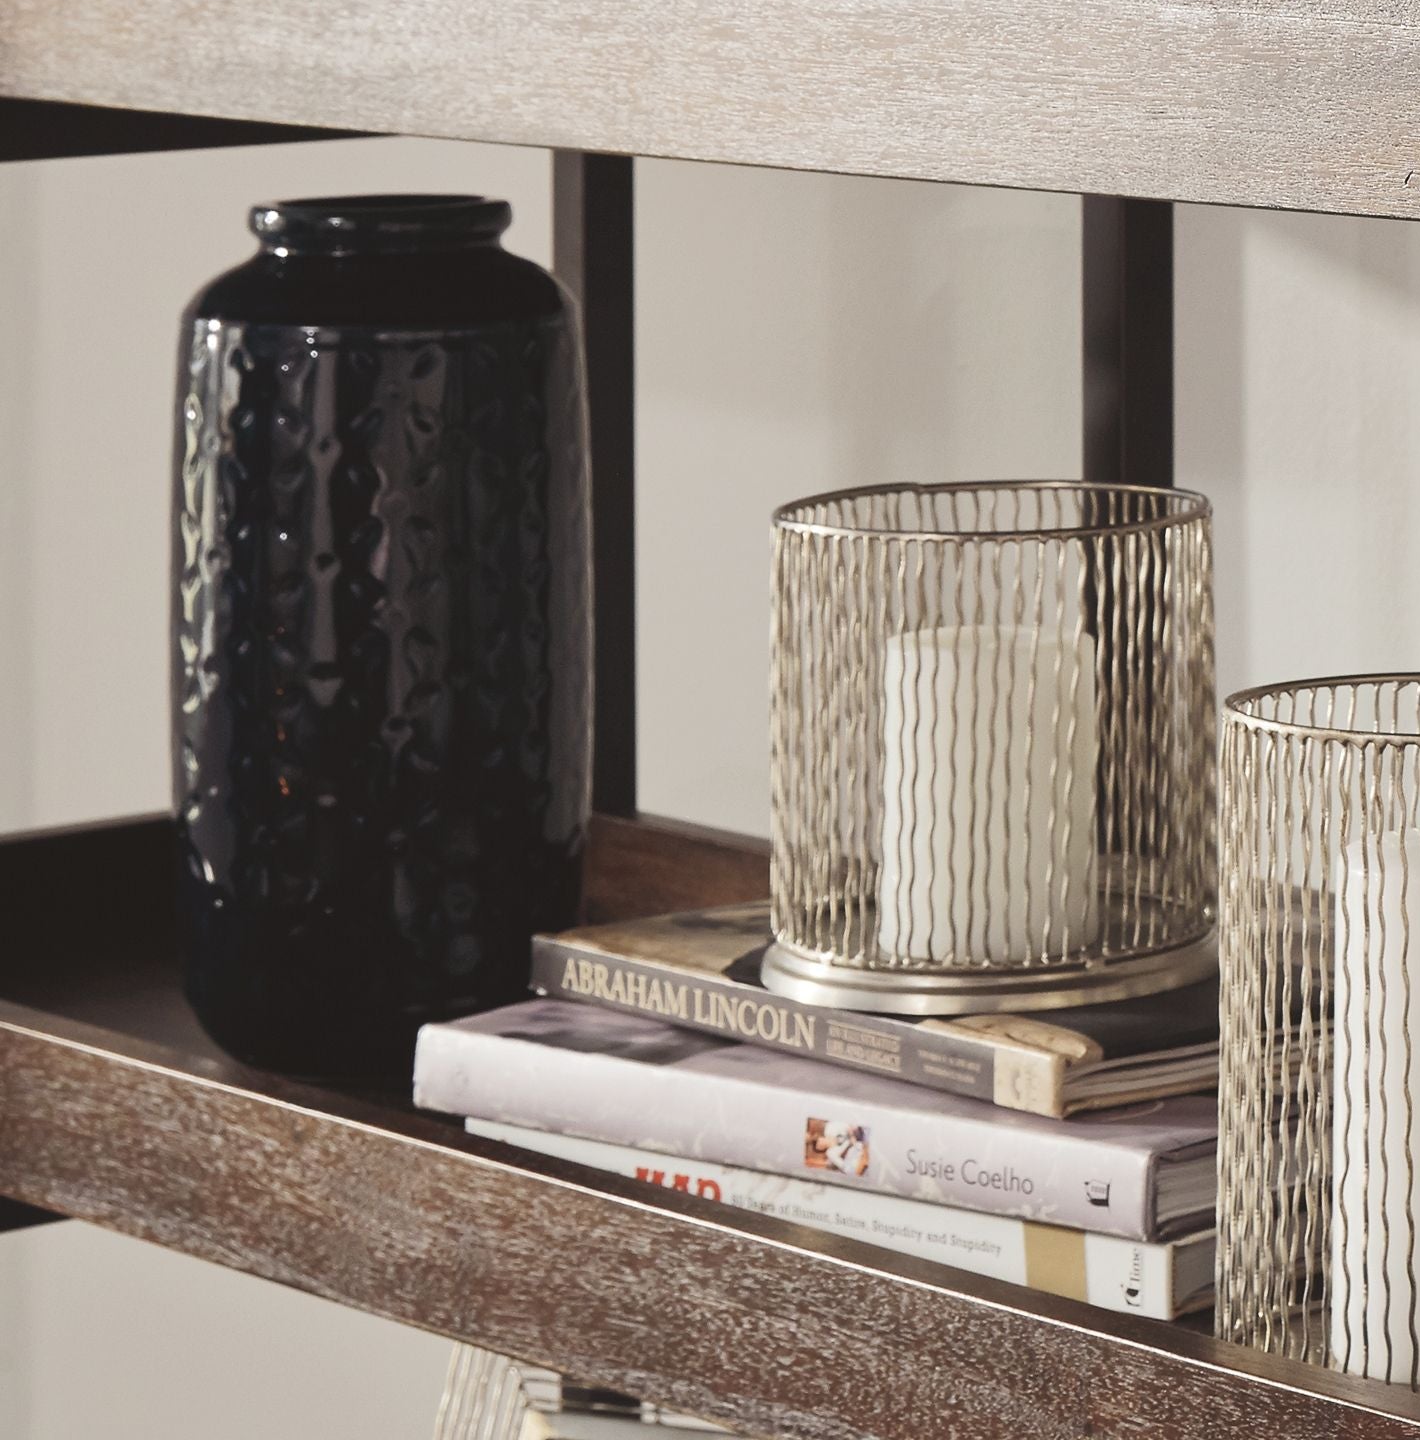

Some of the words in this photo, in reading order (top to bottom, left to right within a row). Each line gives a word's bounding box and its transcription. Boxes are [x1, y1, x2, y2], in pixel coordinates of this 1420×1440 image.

[560, 957, 689, 1020] ABRAHAM
[693, 987, 816, 1051] LINCOLN
[905, 1148, 956, 1182] Susie
[960, 1159, 1035, 1196] Coelho
[927, 1229, 947, 1246] and
